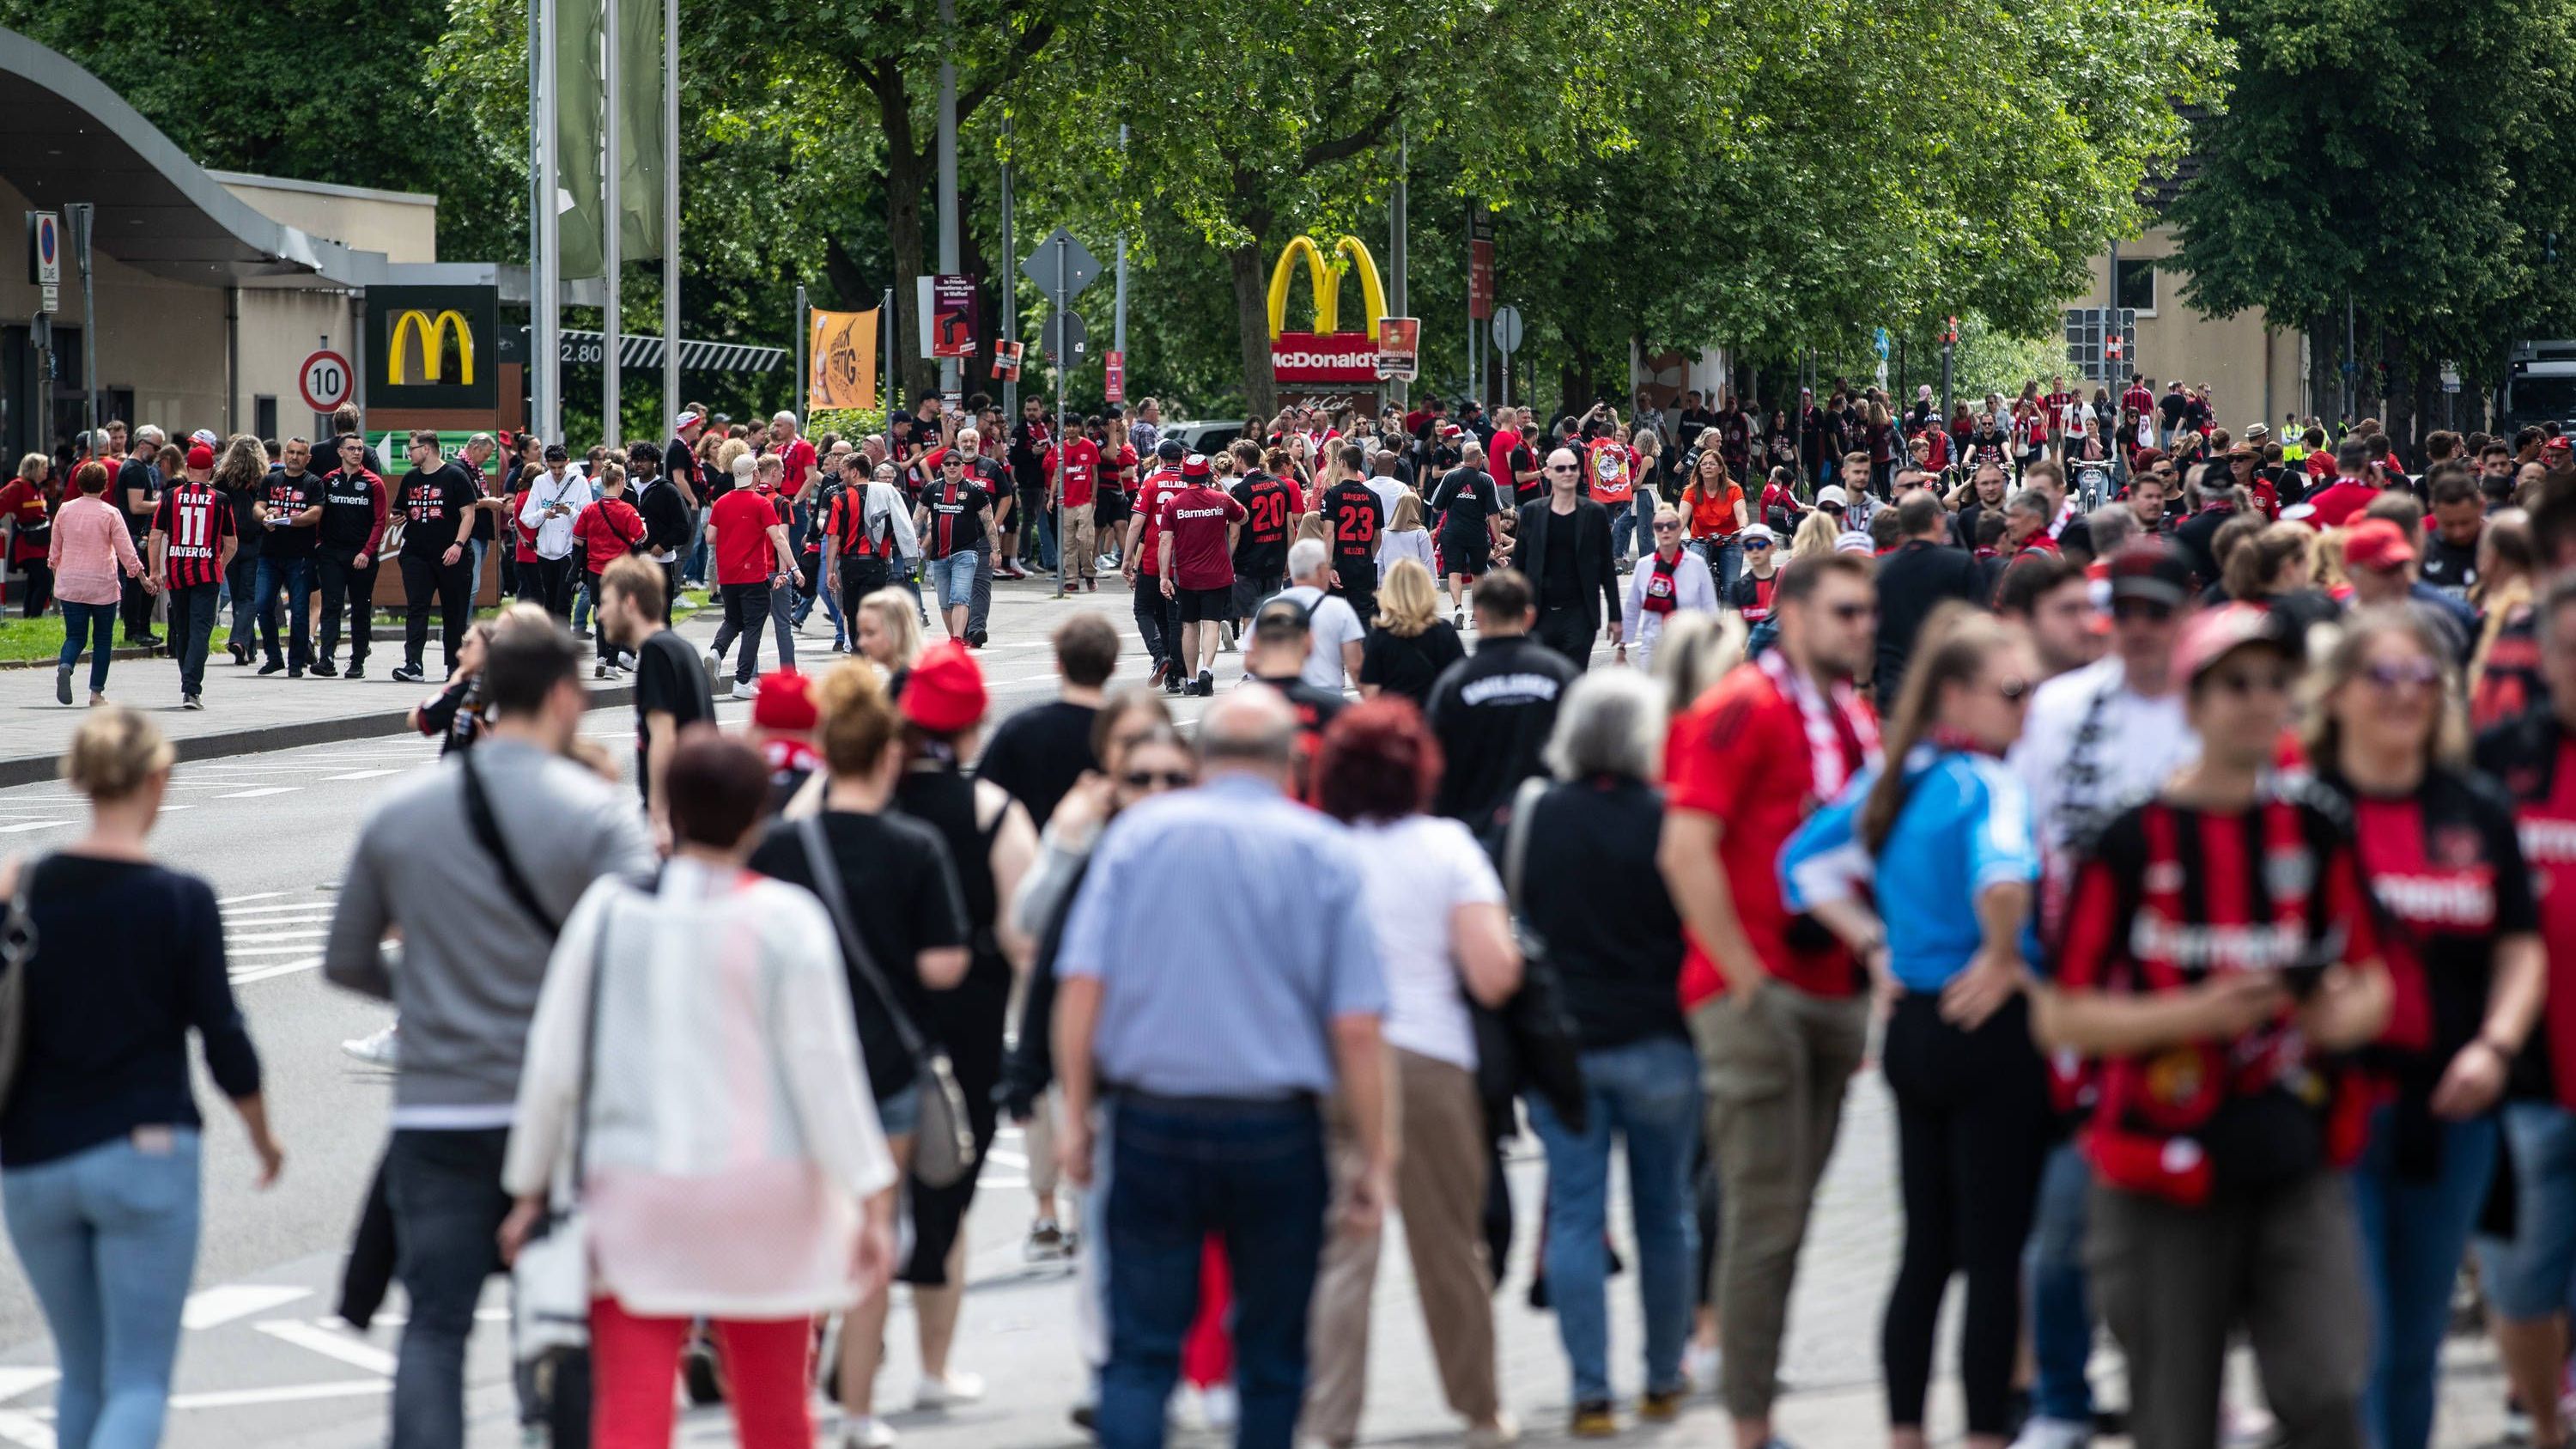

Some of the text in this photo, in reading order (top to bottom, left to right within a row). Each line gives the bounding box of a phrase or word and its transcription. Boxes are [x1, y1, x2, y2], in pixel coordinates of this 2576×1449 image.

[561, 344, 602, 362] 2.80
[1272, 352, 1379, 368] McDonald's
[313, 368, 338, 395] 10
[1296, 395, 1354, 412] McCaf
[178, 493, 213, 505] FRANZ
[283, 486, 292, 517] MEISTE
[327, 493, 369, 506] Barmenia
[933, 502, 964, 511] Barmenia
[1176, 506, 1224, 520] Barmenia
[1252, 491, 1285, 533] 20
[179, 506, 206, 546] 11
[1338, 505, 1374, 542] 23
